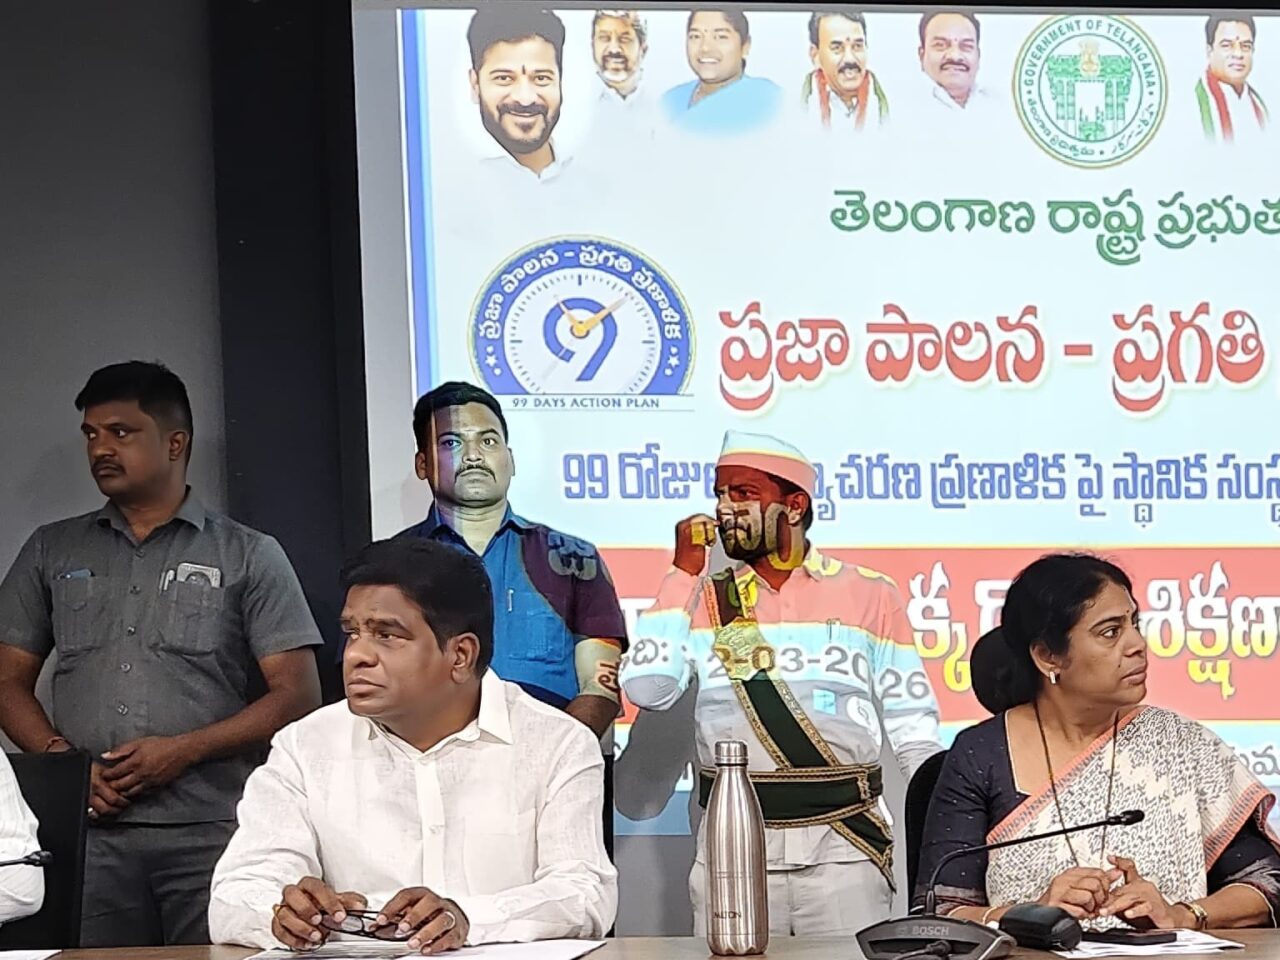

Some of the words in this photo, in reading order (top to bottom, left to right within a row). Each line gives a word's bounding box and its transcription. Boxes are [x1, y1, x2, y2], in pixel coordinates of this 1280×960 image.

[1024, 20, 1081, 86] GOVERNMENT
[1086, 19, 1102, 30] OF
[1107, 23, 1156, 88] TELANGANA
[830, 190, 1036, 234] తెలంగాణ
[1046, 189, 1145, 266] రాష్ట్ర
[719, 303, 850, 411] ప్రజా
[866, 303, 1045, 383] పాలన
[1112, 302, 1265, 412] ప్రగతి
[512, 397, 528, 409] 99
[533, 397, 566, 409] DAYS
[570, 397, 622, 409] ACTION
[626, 397, 660, 409] PLAN
[562, 453, 609, 500] 99
[930, 452, 1066, 509] ప్రణాళిక
[1076, 453, 1106, 517] పై
[1112, 451, 1208, 528] స్థానిక
[911, 926, 950, 936] BOSCH
